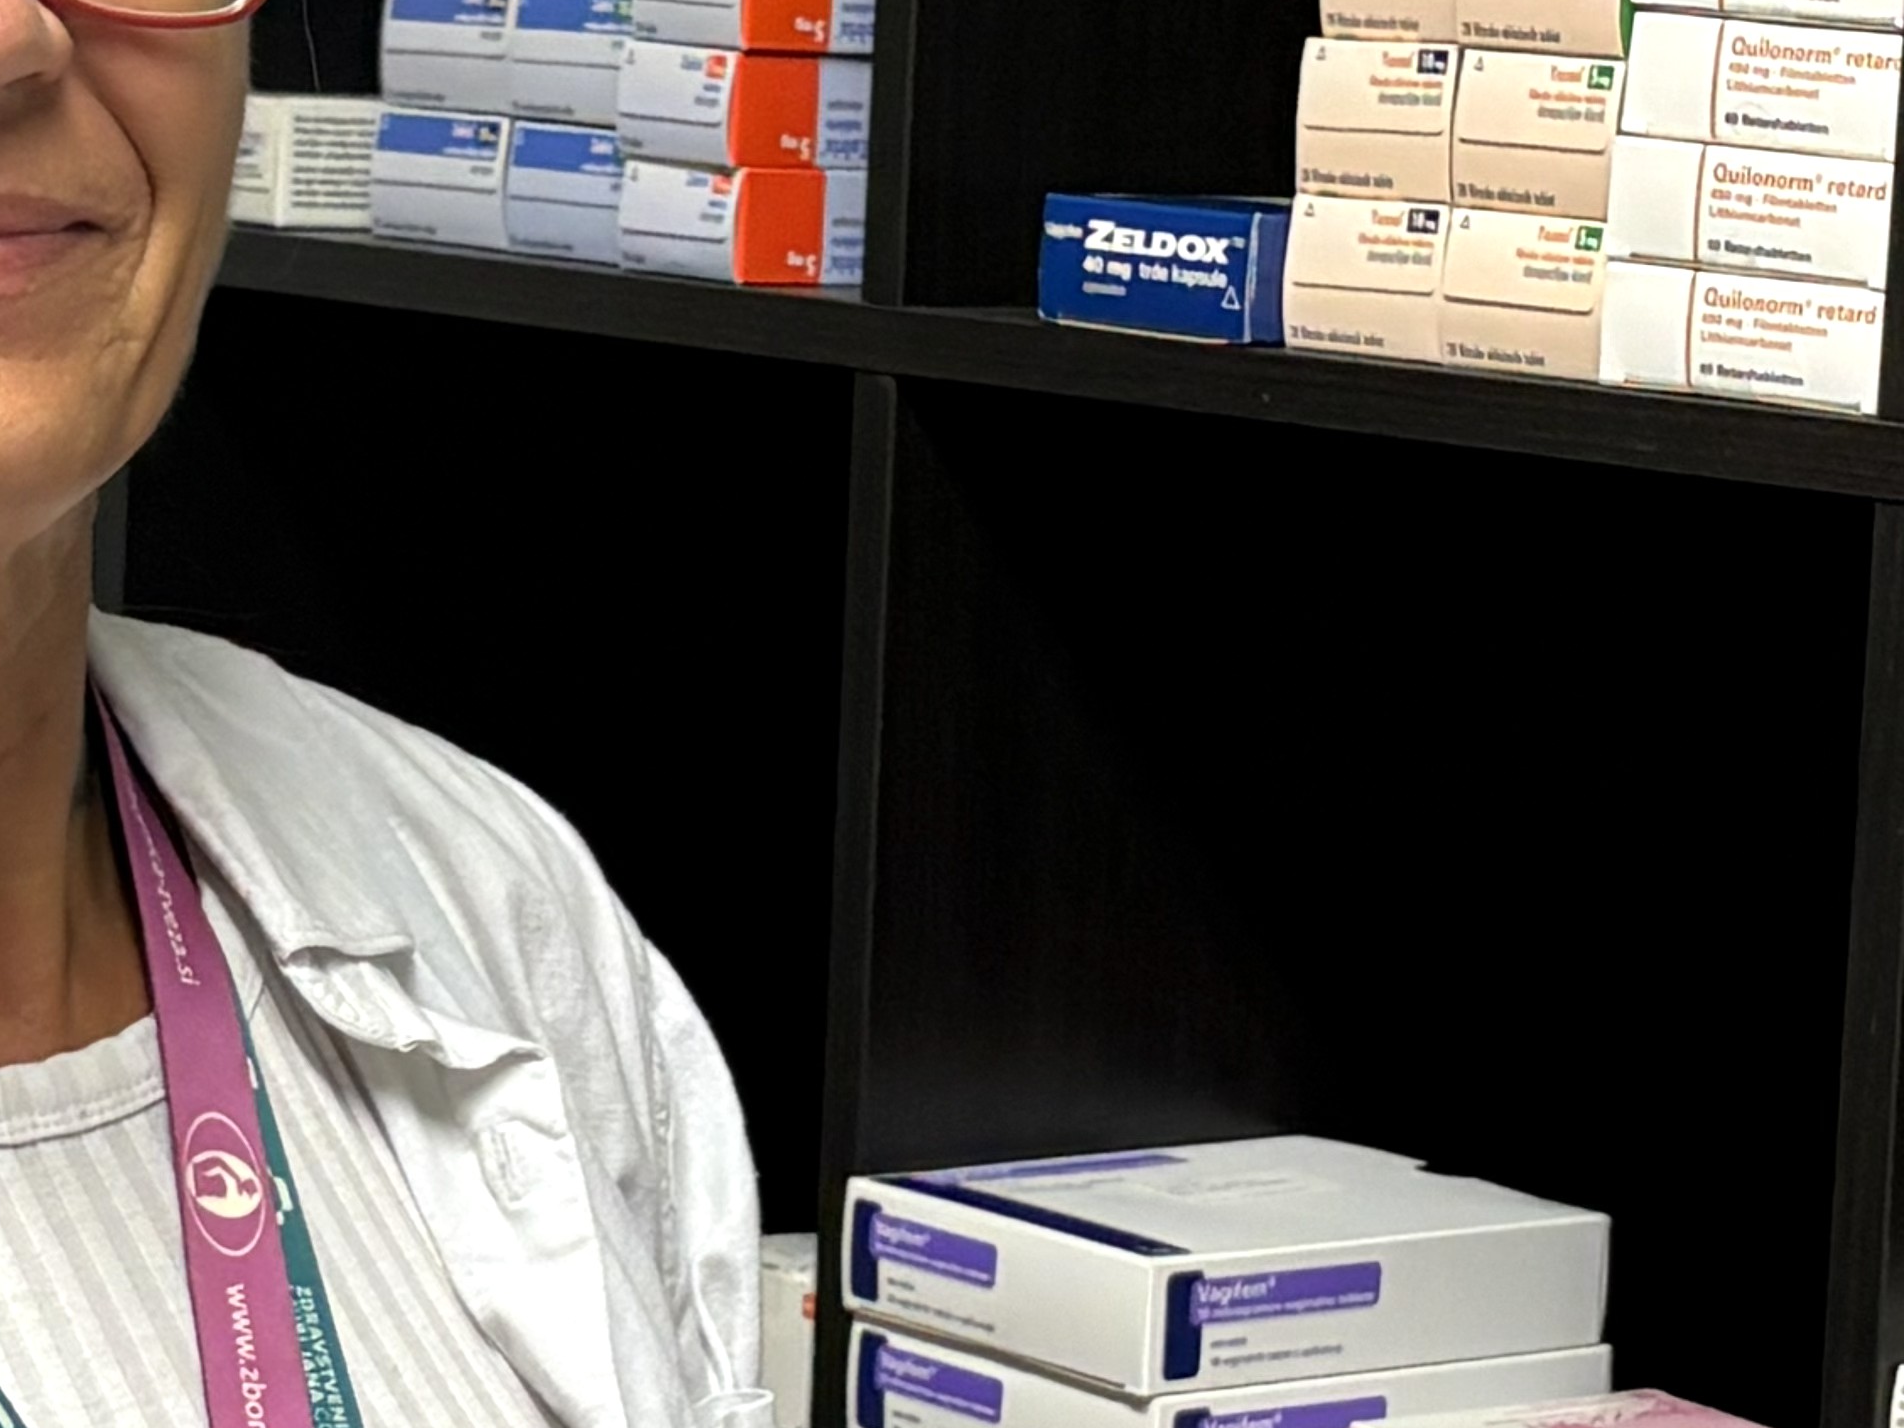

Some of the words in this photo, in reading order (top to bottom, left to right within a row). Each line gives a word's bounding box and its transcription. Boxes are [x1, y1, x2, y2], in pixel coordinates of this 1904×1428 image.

[1827, 181, 1888, 201] retard
[1084, 218, 1229, 265] ZELDOX
[1817, 305, 1878, 325] retard
